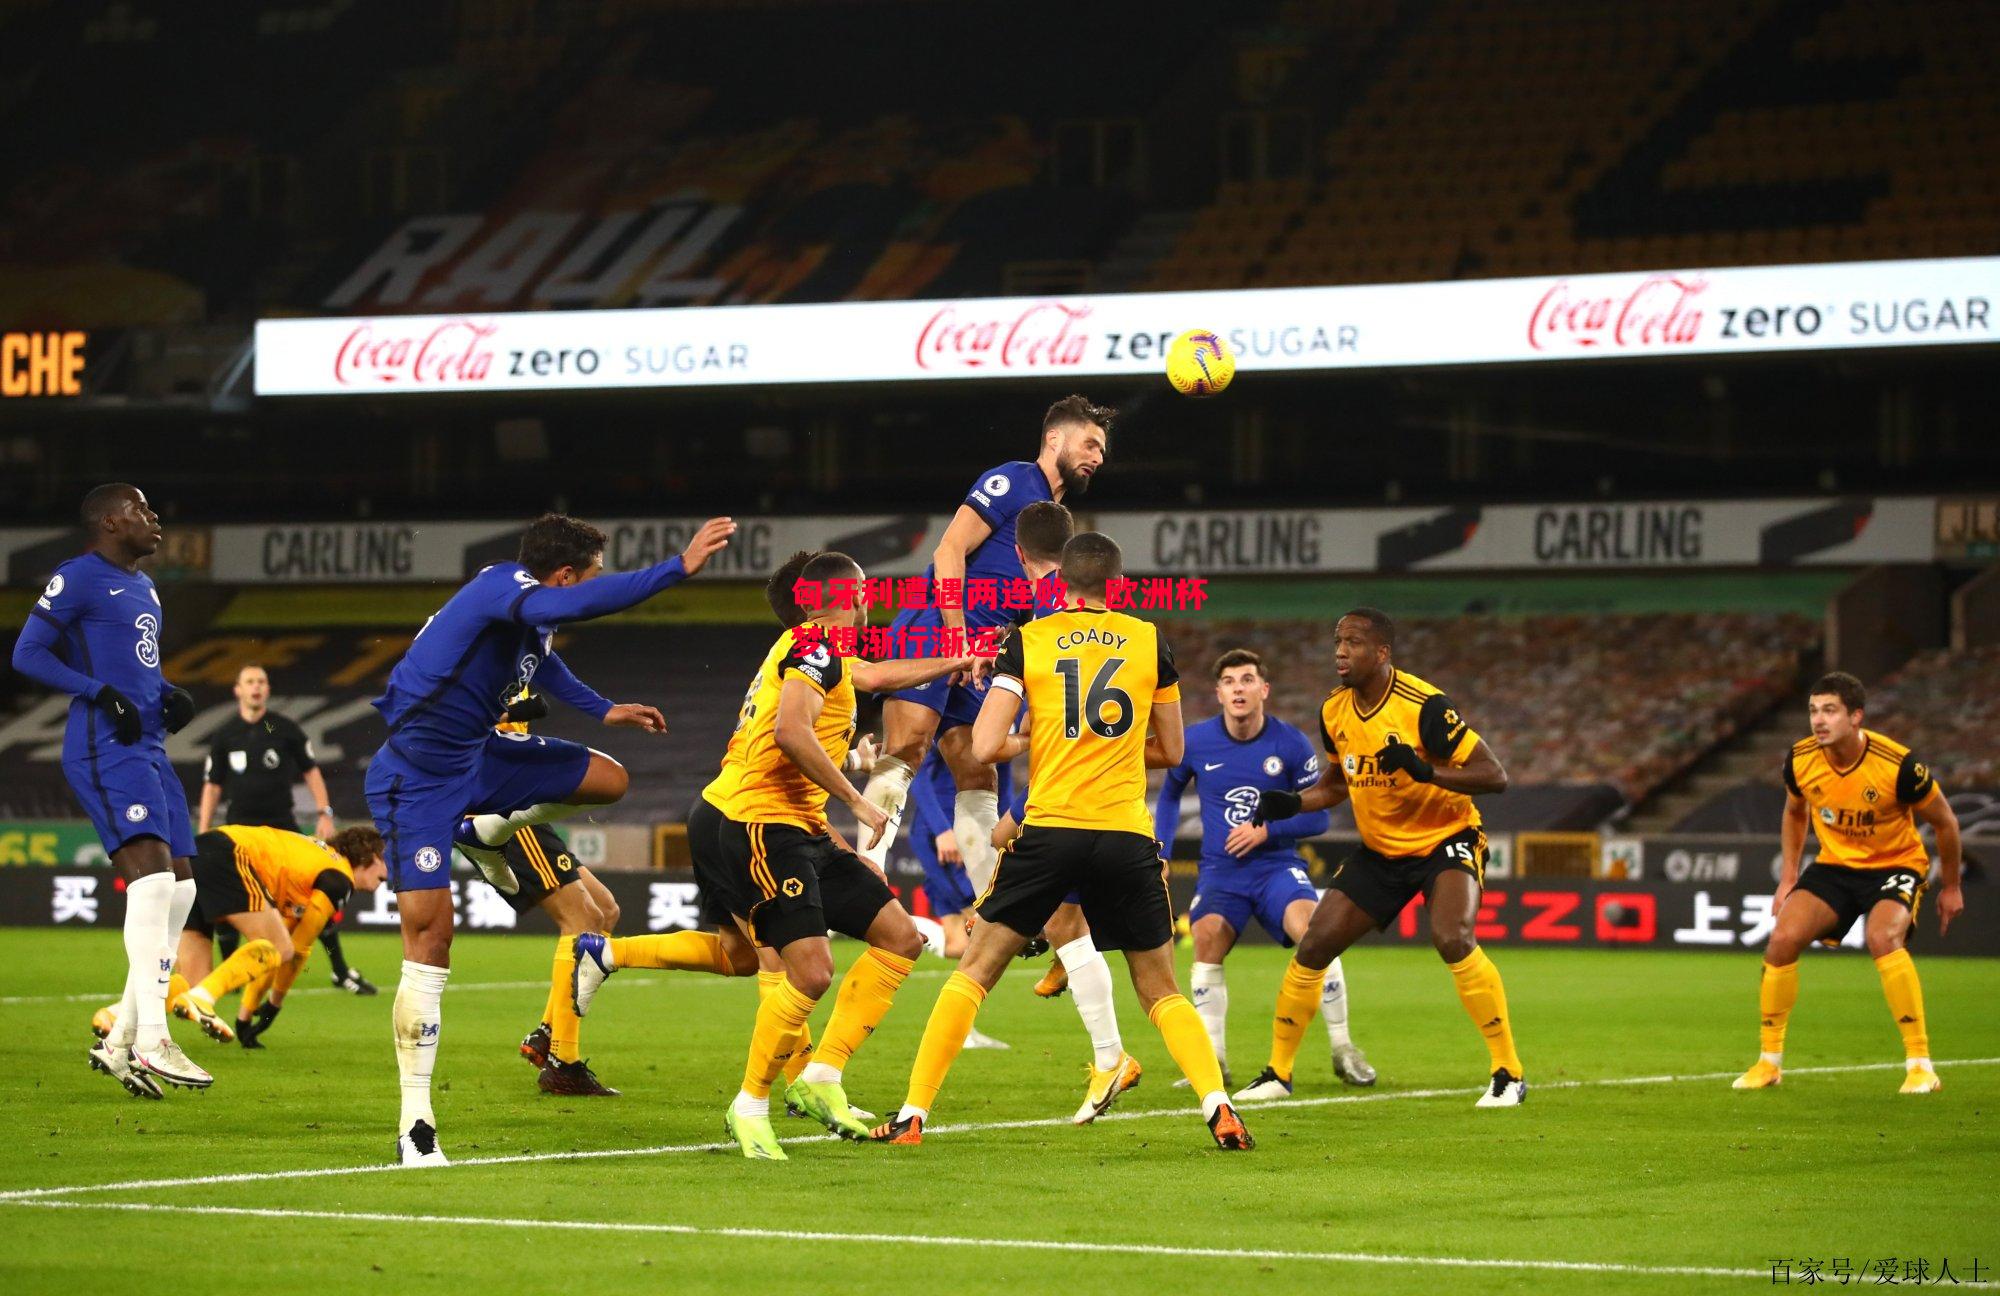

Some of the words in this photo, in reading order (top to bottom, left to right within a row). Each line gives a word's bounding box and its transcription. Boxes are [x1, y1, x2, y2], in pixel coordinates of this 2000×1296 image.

[324, 200, 746, 306] RAUL
[1720, 304, 1822, 340] zero
[1851, 297, 1990, 334] SUGAR
[2, 332, 86, 397] CHE
[509, 345, 600, 376] zero
[625, 343, 749, 374] SUGAR
[1106, 330, 1173, 361] zer
[1231, 325, 1360, 357] SUGAR
[263, 527, 413, 575] CARLING
[613, 522, 772, 571] CARNG
[1154, 513, 1321, 568] CARLING
[1532, 504, 1704, 560] CARLING
[1057, 628, 1127, 650] COADY
[1054, 658, 1134, 739] 16
[1445, 842, 1474, 861] 15
